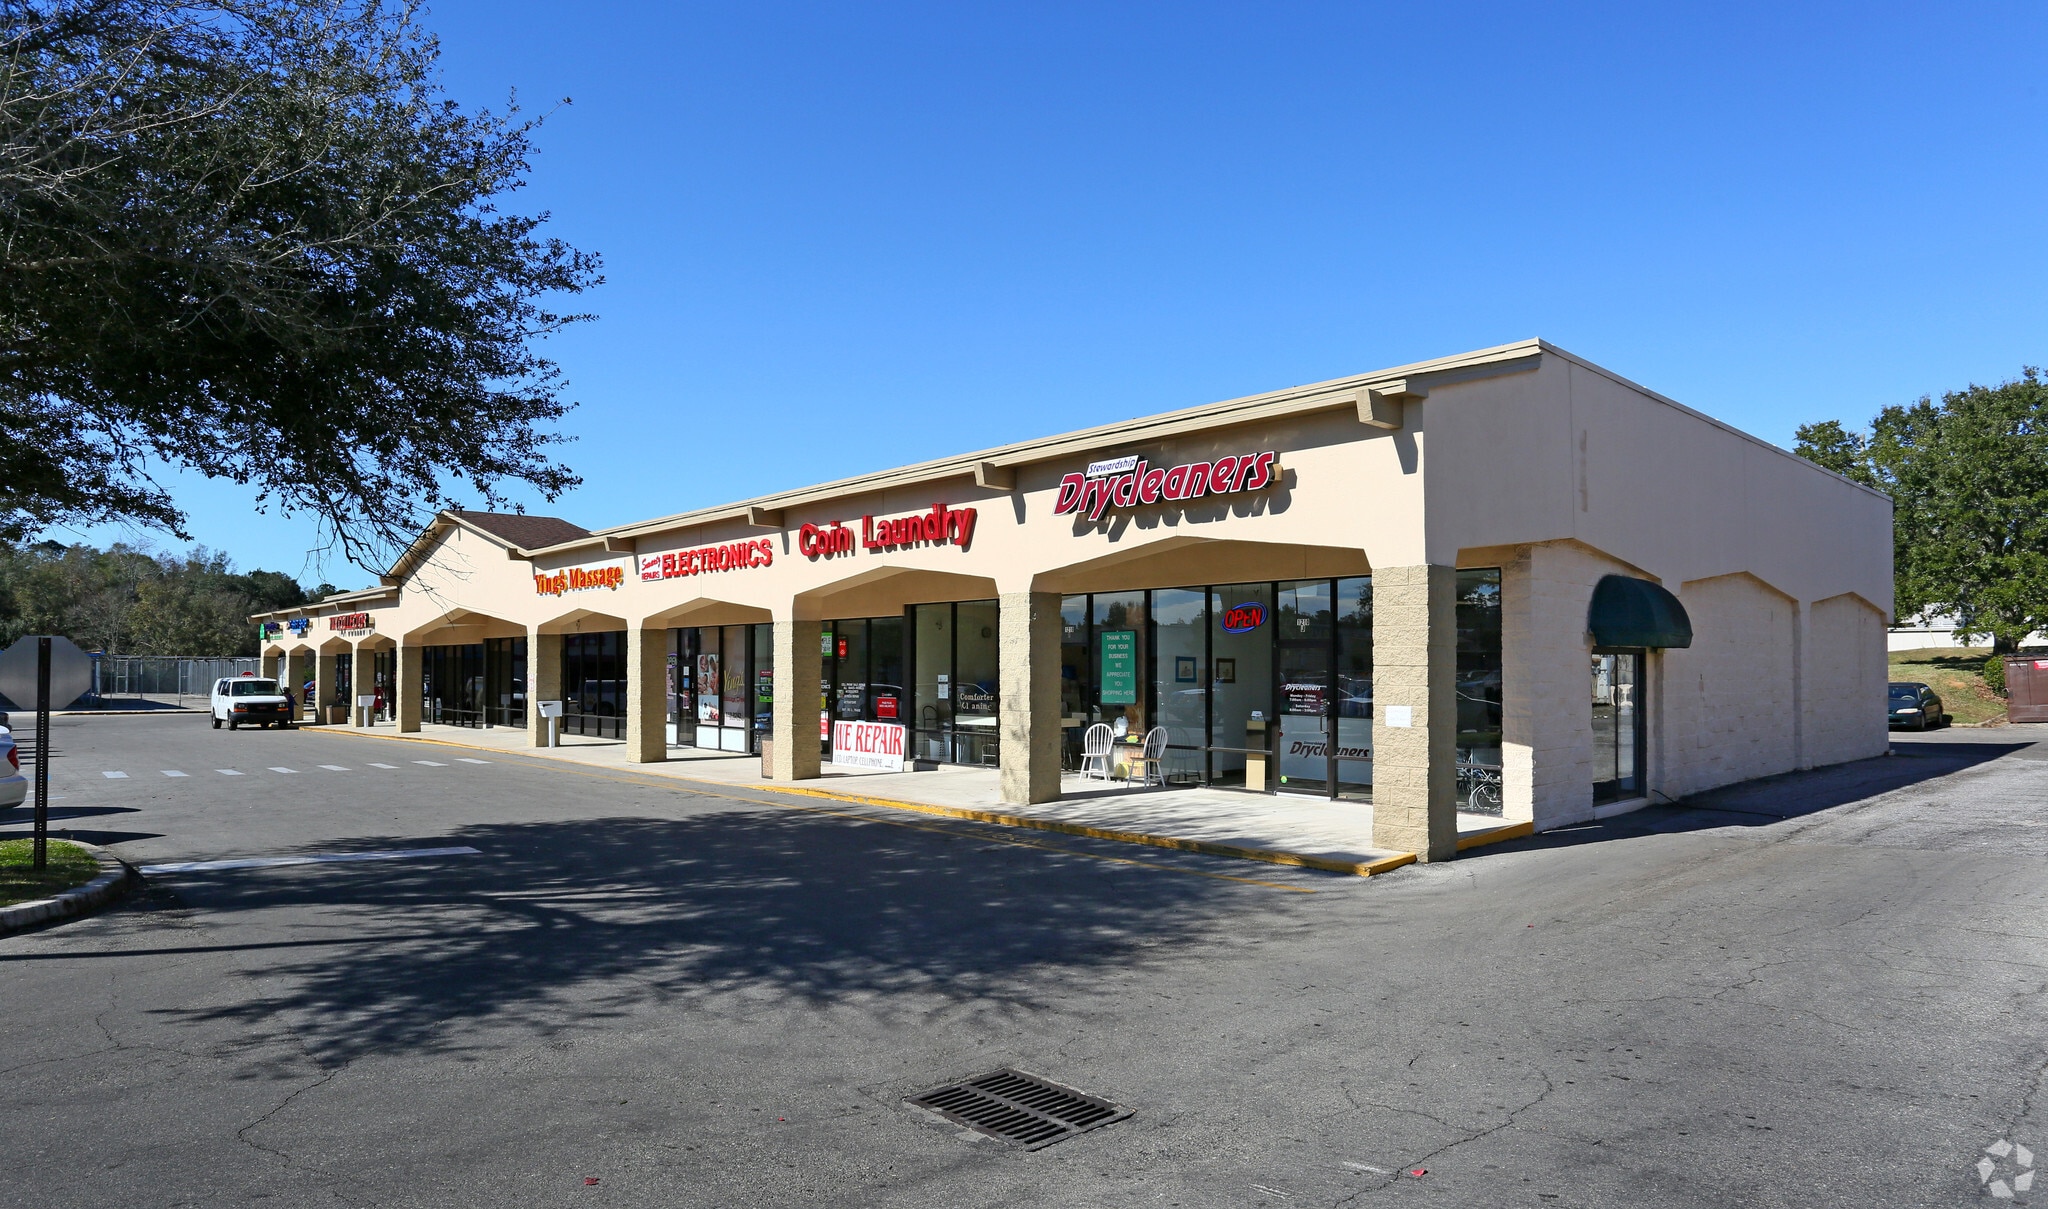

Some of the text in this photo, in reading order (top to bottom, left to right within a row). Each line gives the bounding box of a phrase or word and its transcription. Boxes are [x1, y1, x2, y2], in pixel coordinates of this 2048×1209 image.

[1089, 457, 1136, 474] Stewardship
[1052, 451, 1275, 522] Drycleaners
[799, 503, 977, 556] Coin Laundry
[662, 539, 773, 578] ELECTRONICS
[535, 564, 624, 596] Ying's Massage
[641, 571, 660, 580] REPAIRS
[1224, 608, 1262, 629] OPEN
[960, 693, 994, 701] Comforter
[1285, 683, 1321, 692] Drycleaners
[961, 702, 992, 711] Claning
[836, 723, 903, 756] WE REPAIR
